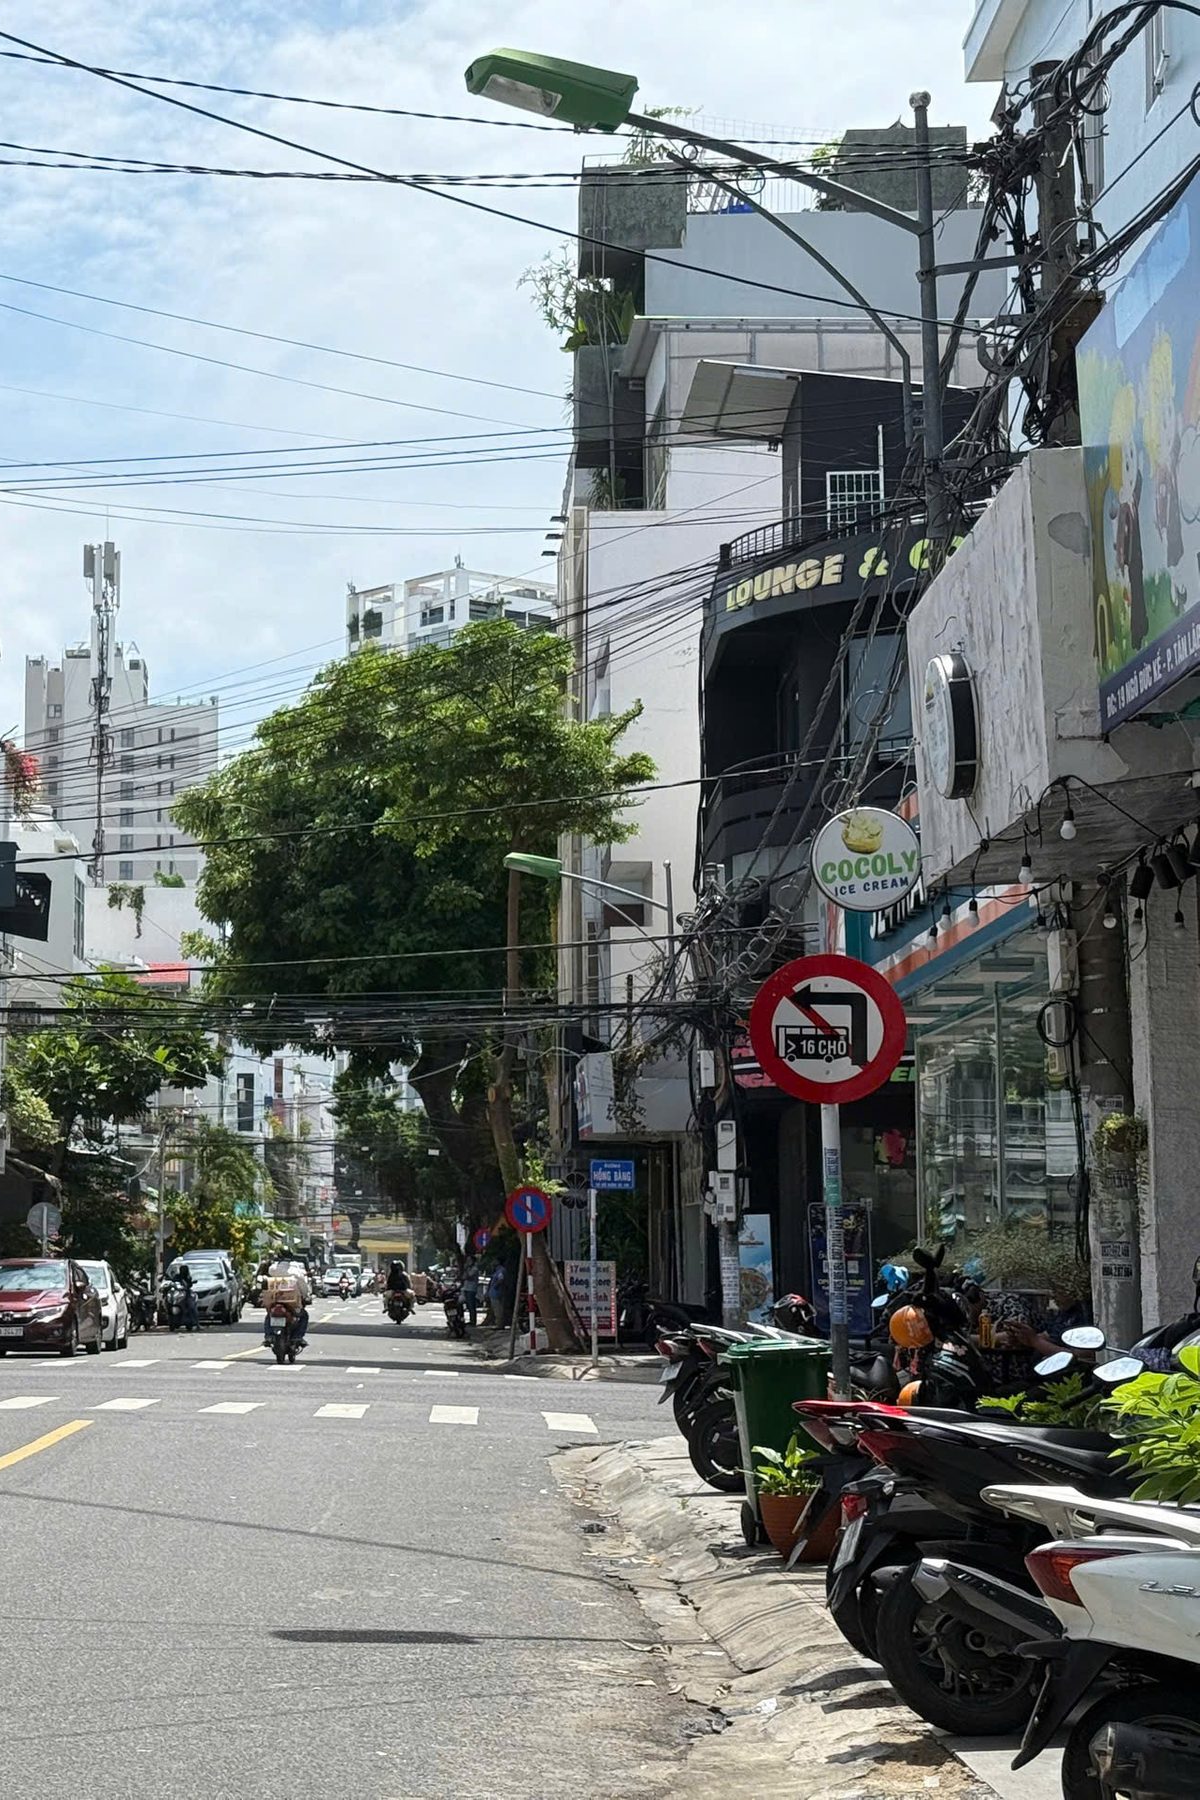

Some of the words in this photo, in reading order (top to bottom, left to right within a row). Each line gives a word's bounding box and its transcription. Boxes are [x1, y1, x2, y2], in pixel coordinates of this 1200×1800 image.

[726, 554, 845, 612] LOUNGE
[858, 546, 890, 579] &
[820, 850, 917, 884] COCOLY
[834, 884, 856, 897] ICE
[863, 877, 909, 892] CREAM
[800, 1040, 815, 1055] 16
